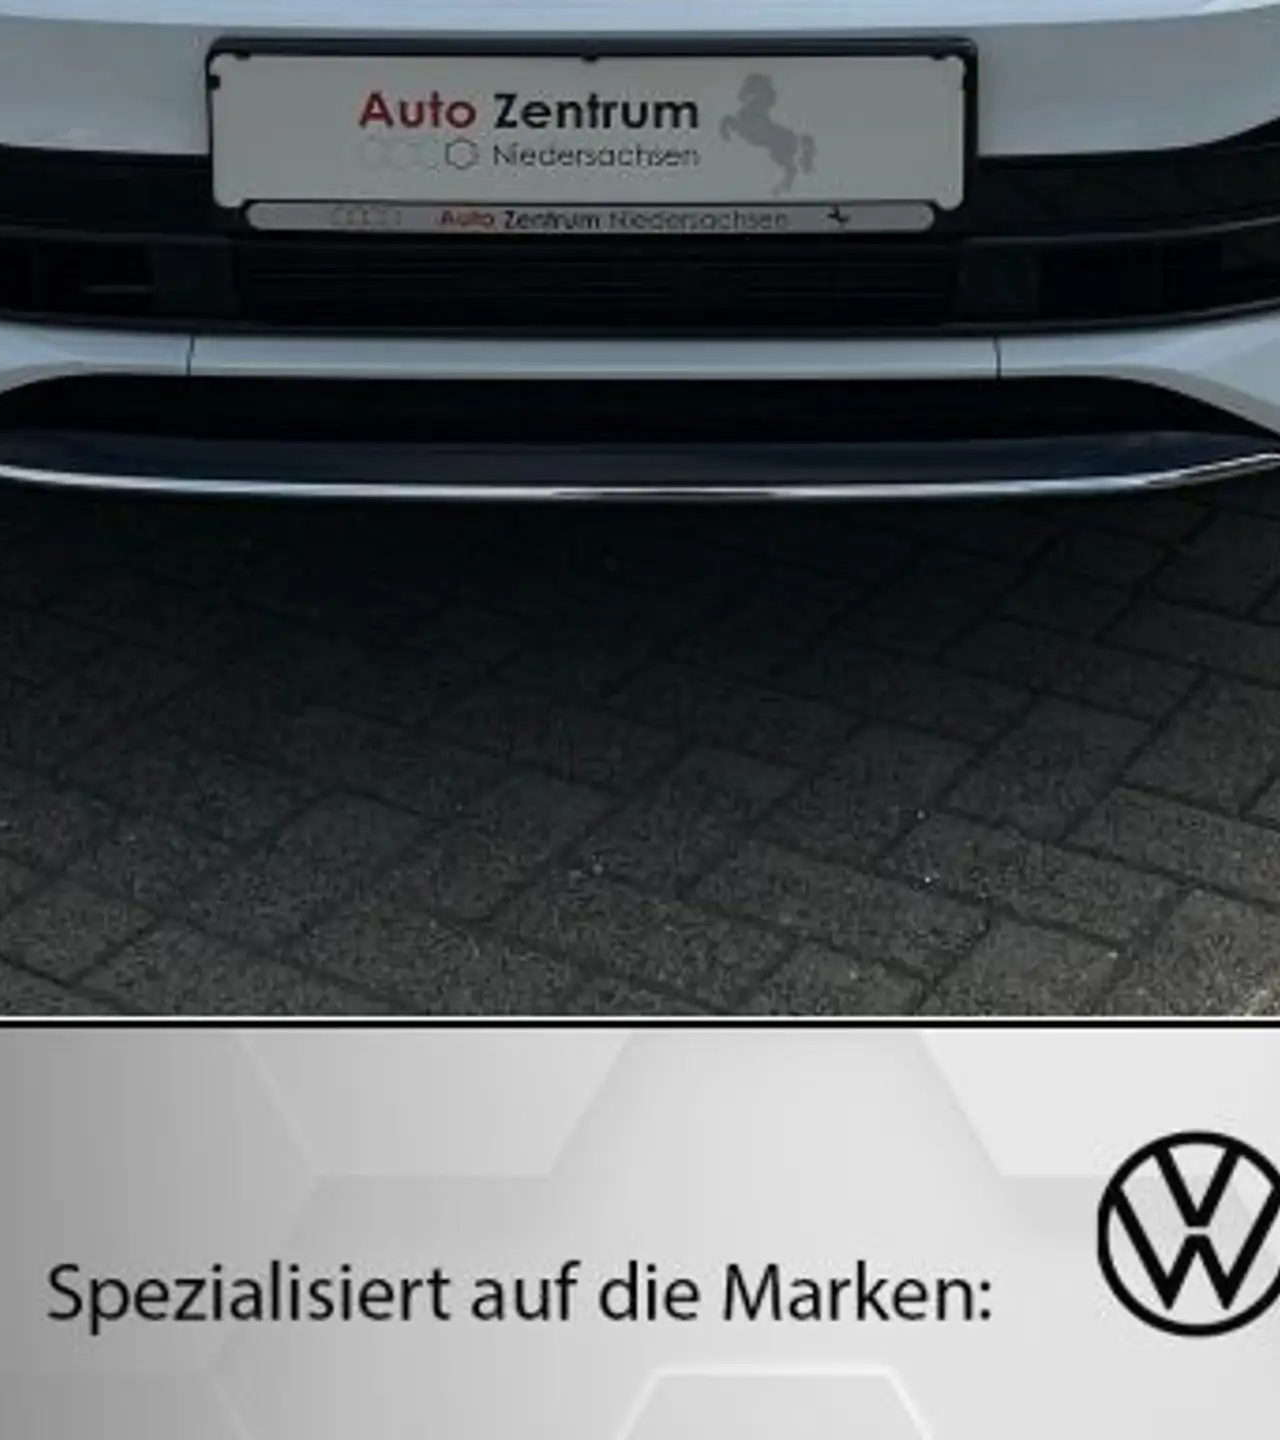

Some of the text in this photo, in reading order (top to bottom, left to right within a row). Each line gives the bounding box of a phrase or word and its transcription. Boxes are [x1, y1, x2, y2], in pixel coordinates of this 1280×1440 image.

[358, 90, 700, 130] Auto Zentrum
[492, 140, 701, 167] Niedersachsen
[439, 208, 496, 228] Auto
[503, 208, 601, 230] Zentrum
